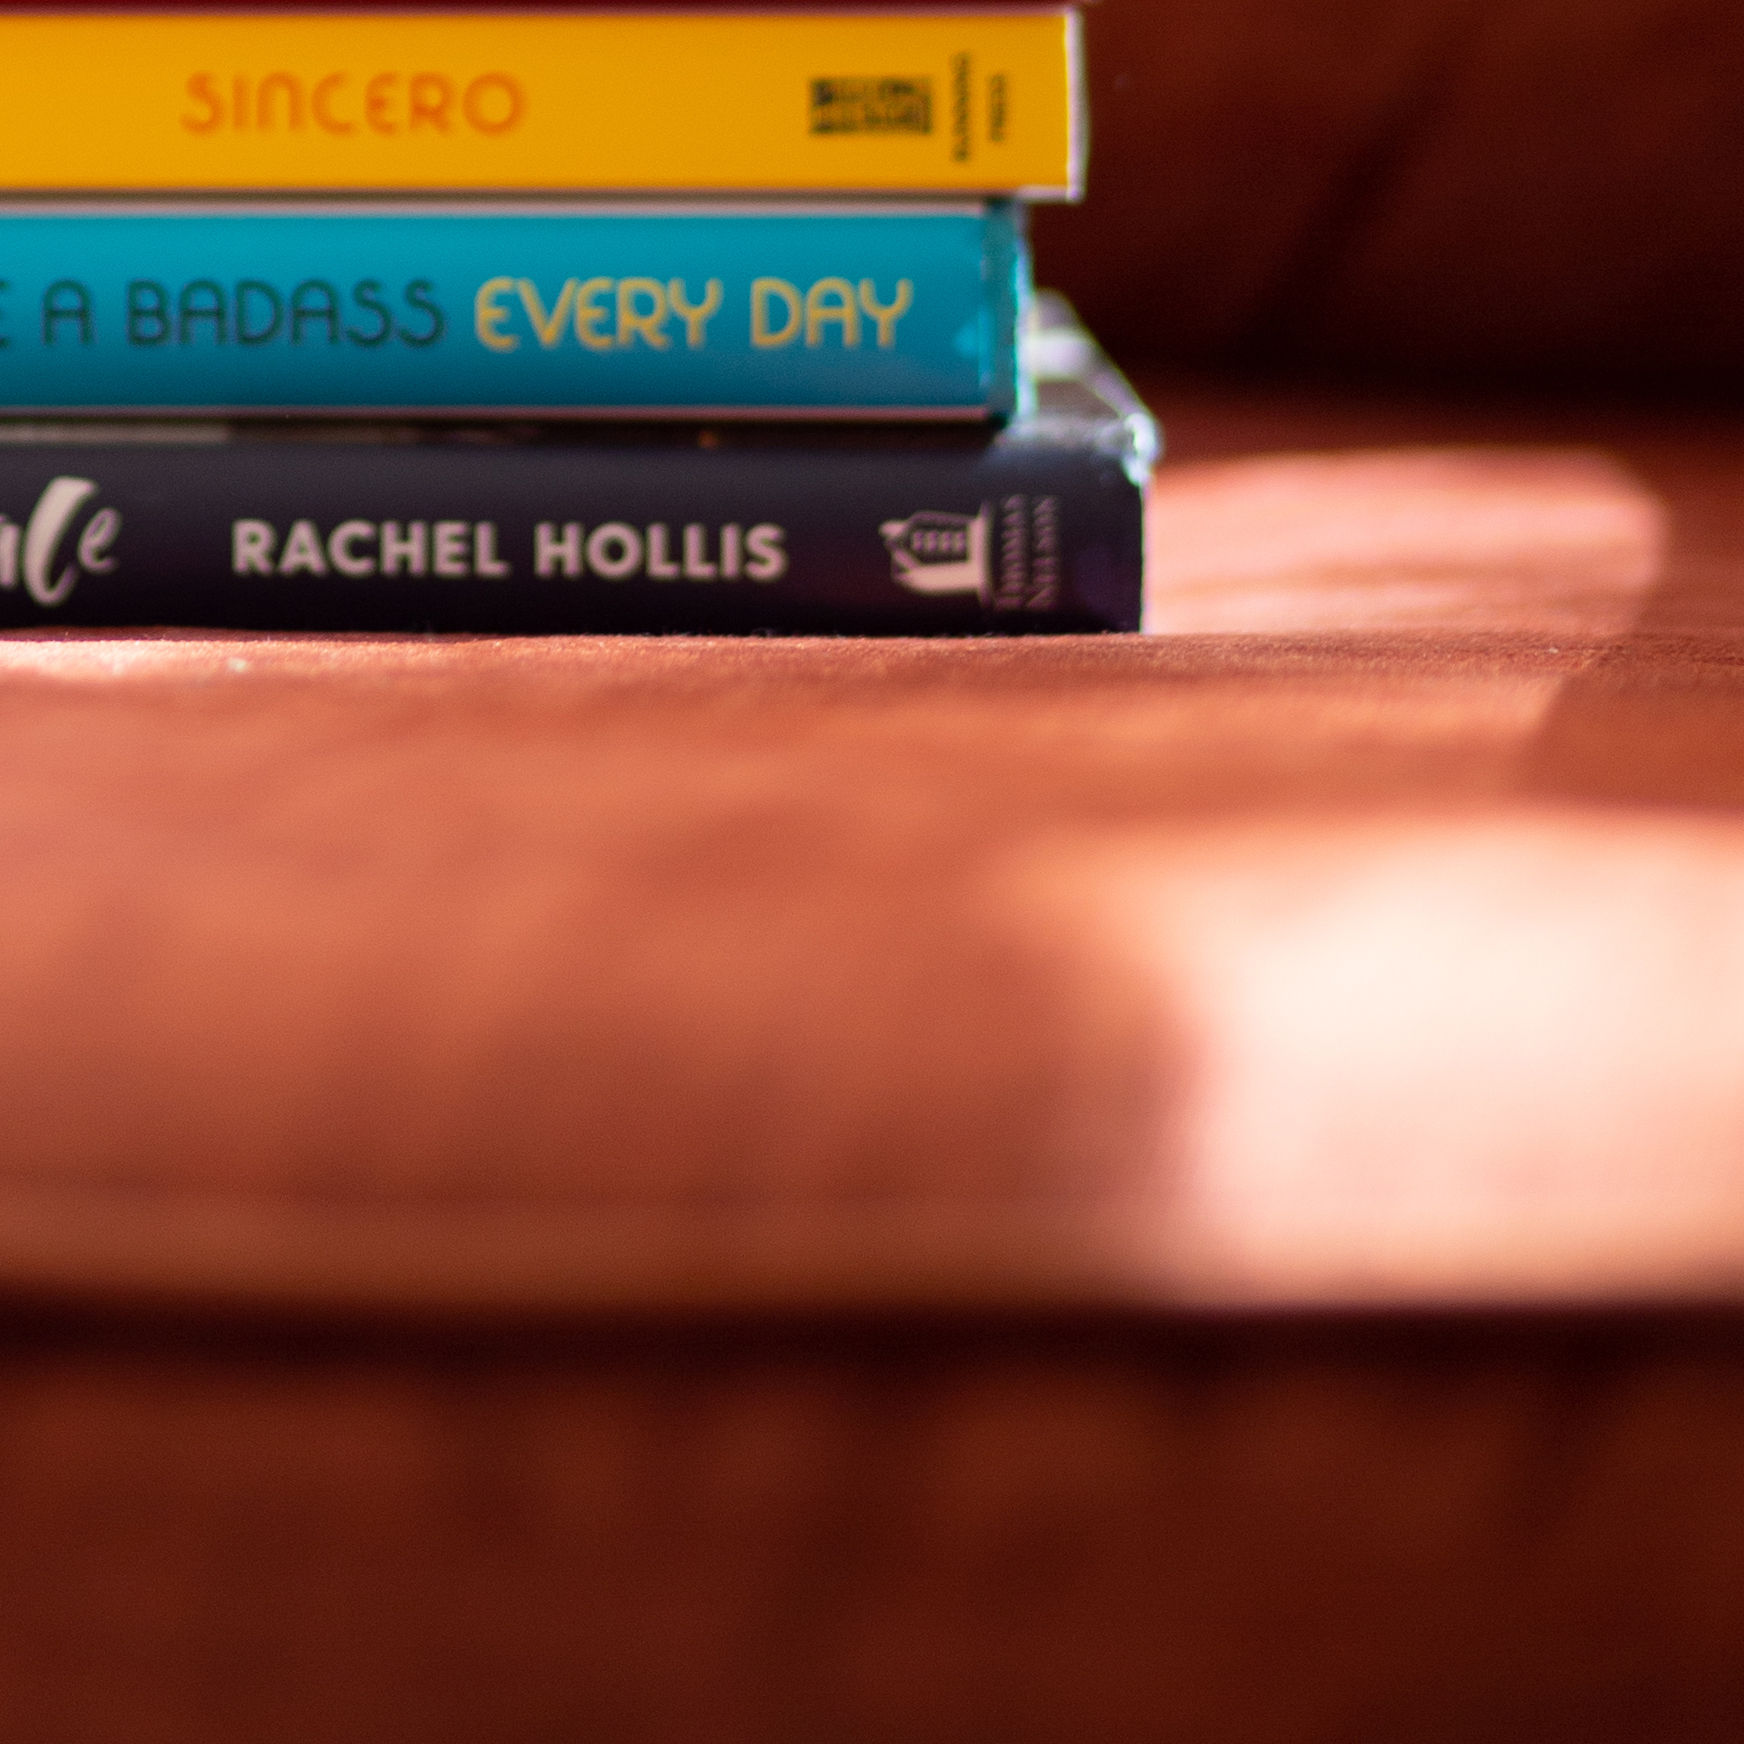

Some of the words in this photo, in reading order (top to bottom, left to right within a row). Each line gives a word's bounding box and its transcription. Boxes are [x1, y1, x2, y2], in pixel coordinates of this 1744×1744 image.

[180, 71, 529, 137] SINCERO
[41, 280, 97, 348] A
[125, 278, 446, 348] BADASS
[474, 277, 724, 349] EVERY
[749, 277, 914, 349] DAY
[230, 519, 509, 577] RACHEL
[533, 522, 788, 579] HOLLIS
